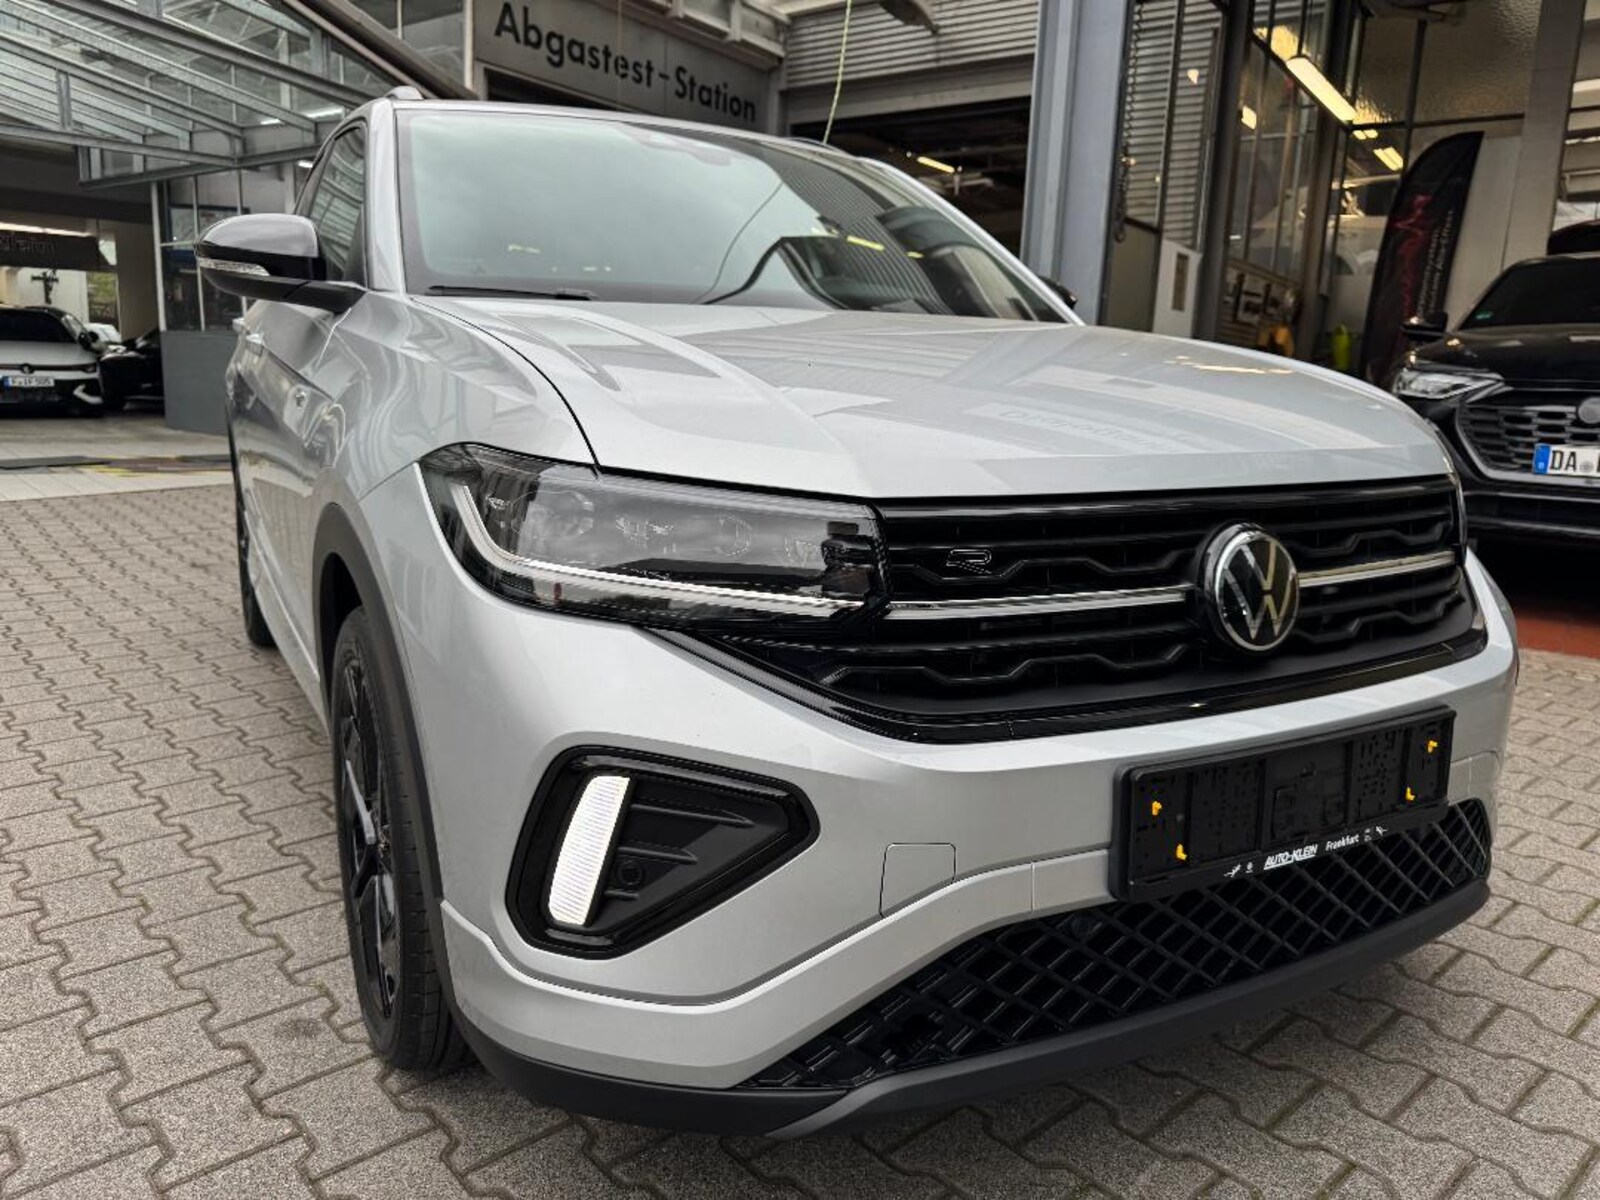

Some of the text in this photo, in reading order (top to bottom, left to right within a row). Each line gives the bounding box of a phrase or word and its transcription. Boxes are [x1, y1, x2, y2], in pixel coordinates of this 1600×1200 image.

[494, 2, 756, 122] Abgastest-Station
[1550, 450, 1576, 472] DA
[1264, 834, 1359, 869] AUTO-KLEIN Frankfurt
